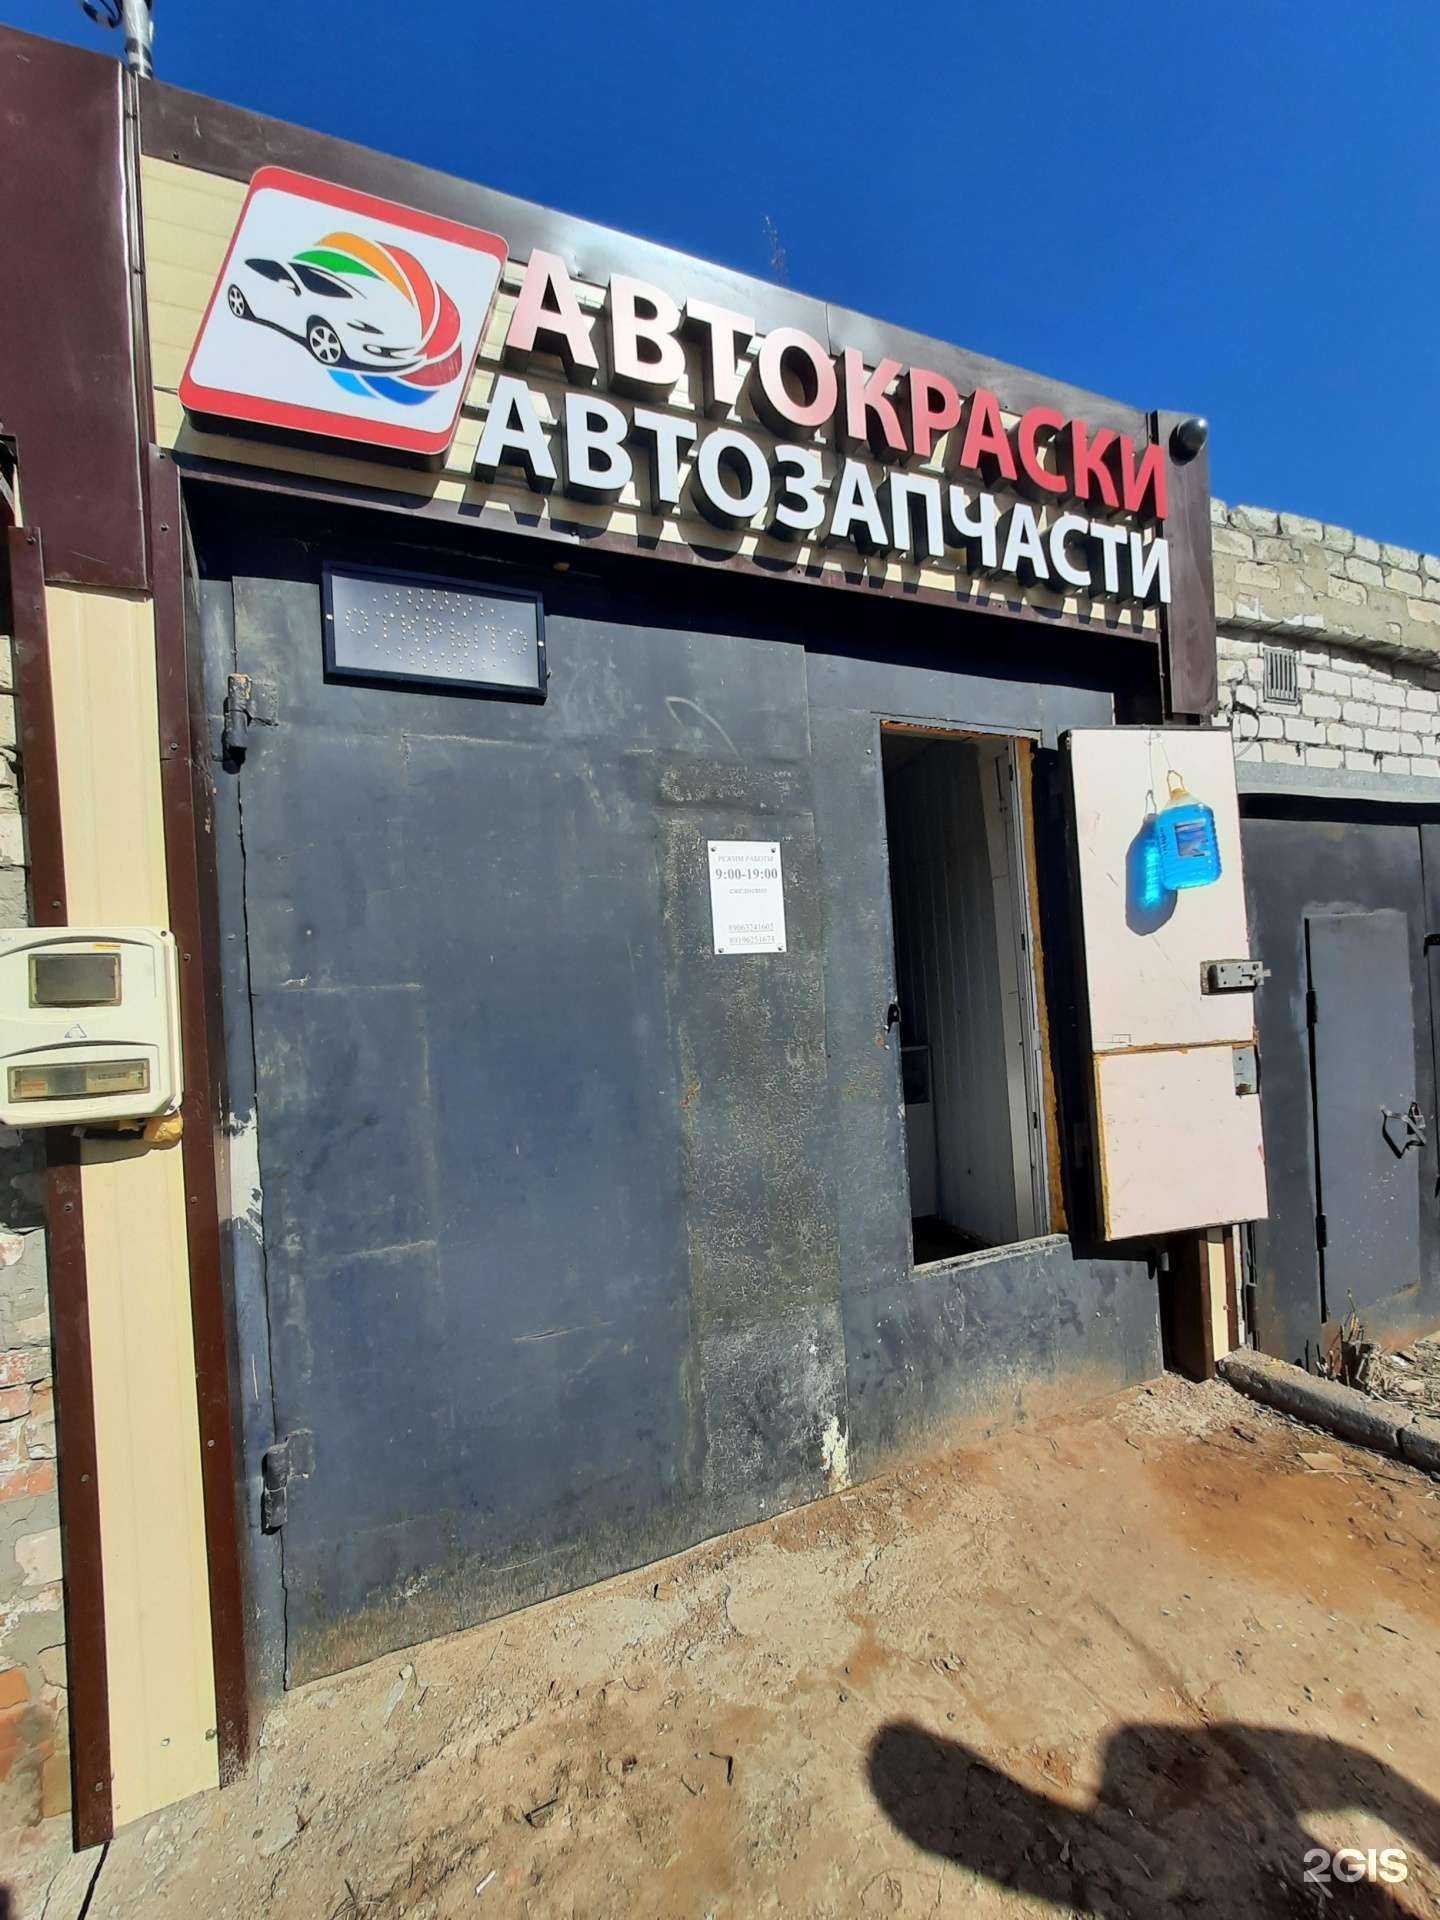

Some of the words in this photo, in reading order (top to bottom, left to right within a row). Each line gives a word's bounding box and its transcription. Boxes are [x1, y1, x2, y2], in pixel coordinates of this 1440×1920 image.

[505, 248, 1169, 521] АВТОКРАСКИ
[474, 375, 1172, 604] АВТОЗАПЧАСТИ
[345, 607, 529, 655] ОТКРЫТО
[715, 868, 778, 880] 9:00-19:00
